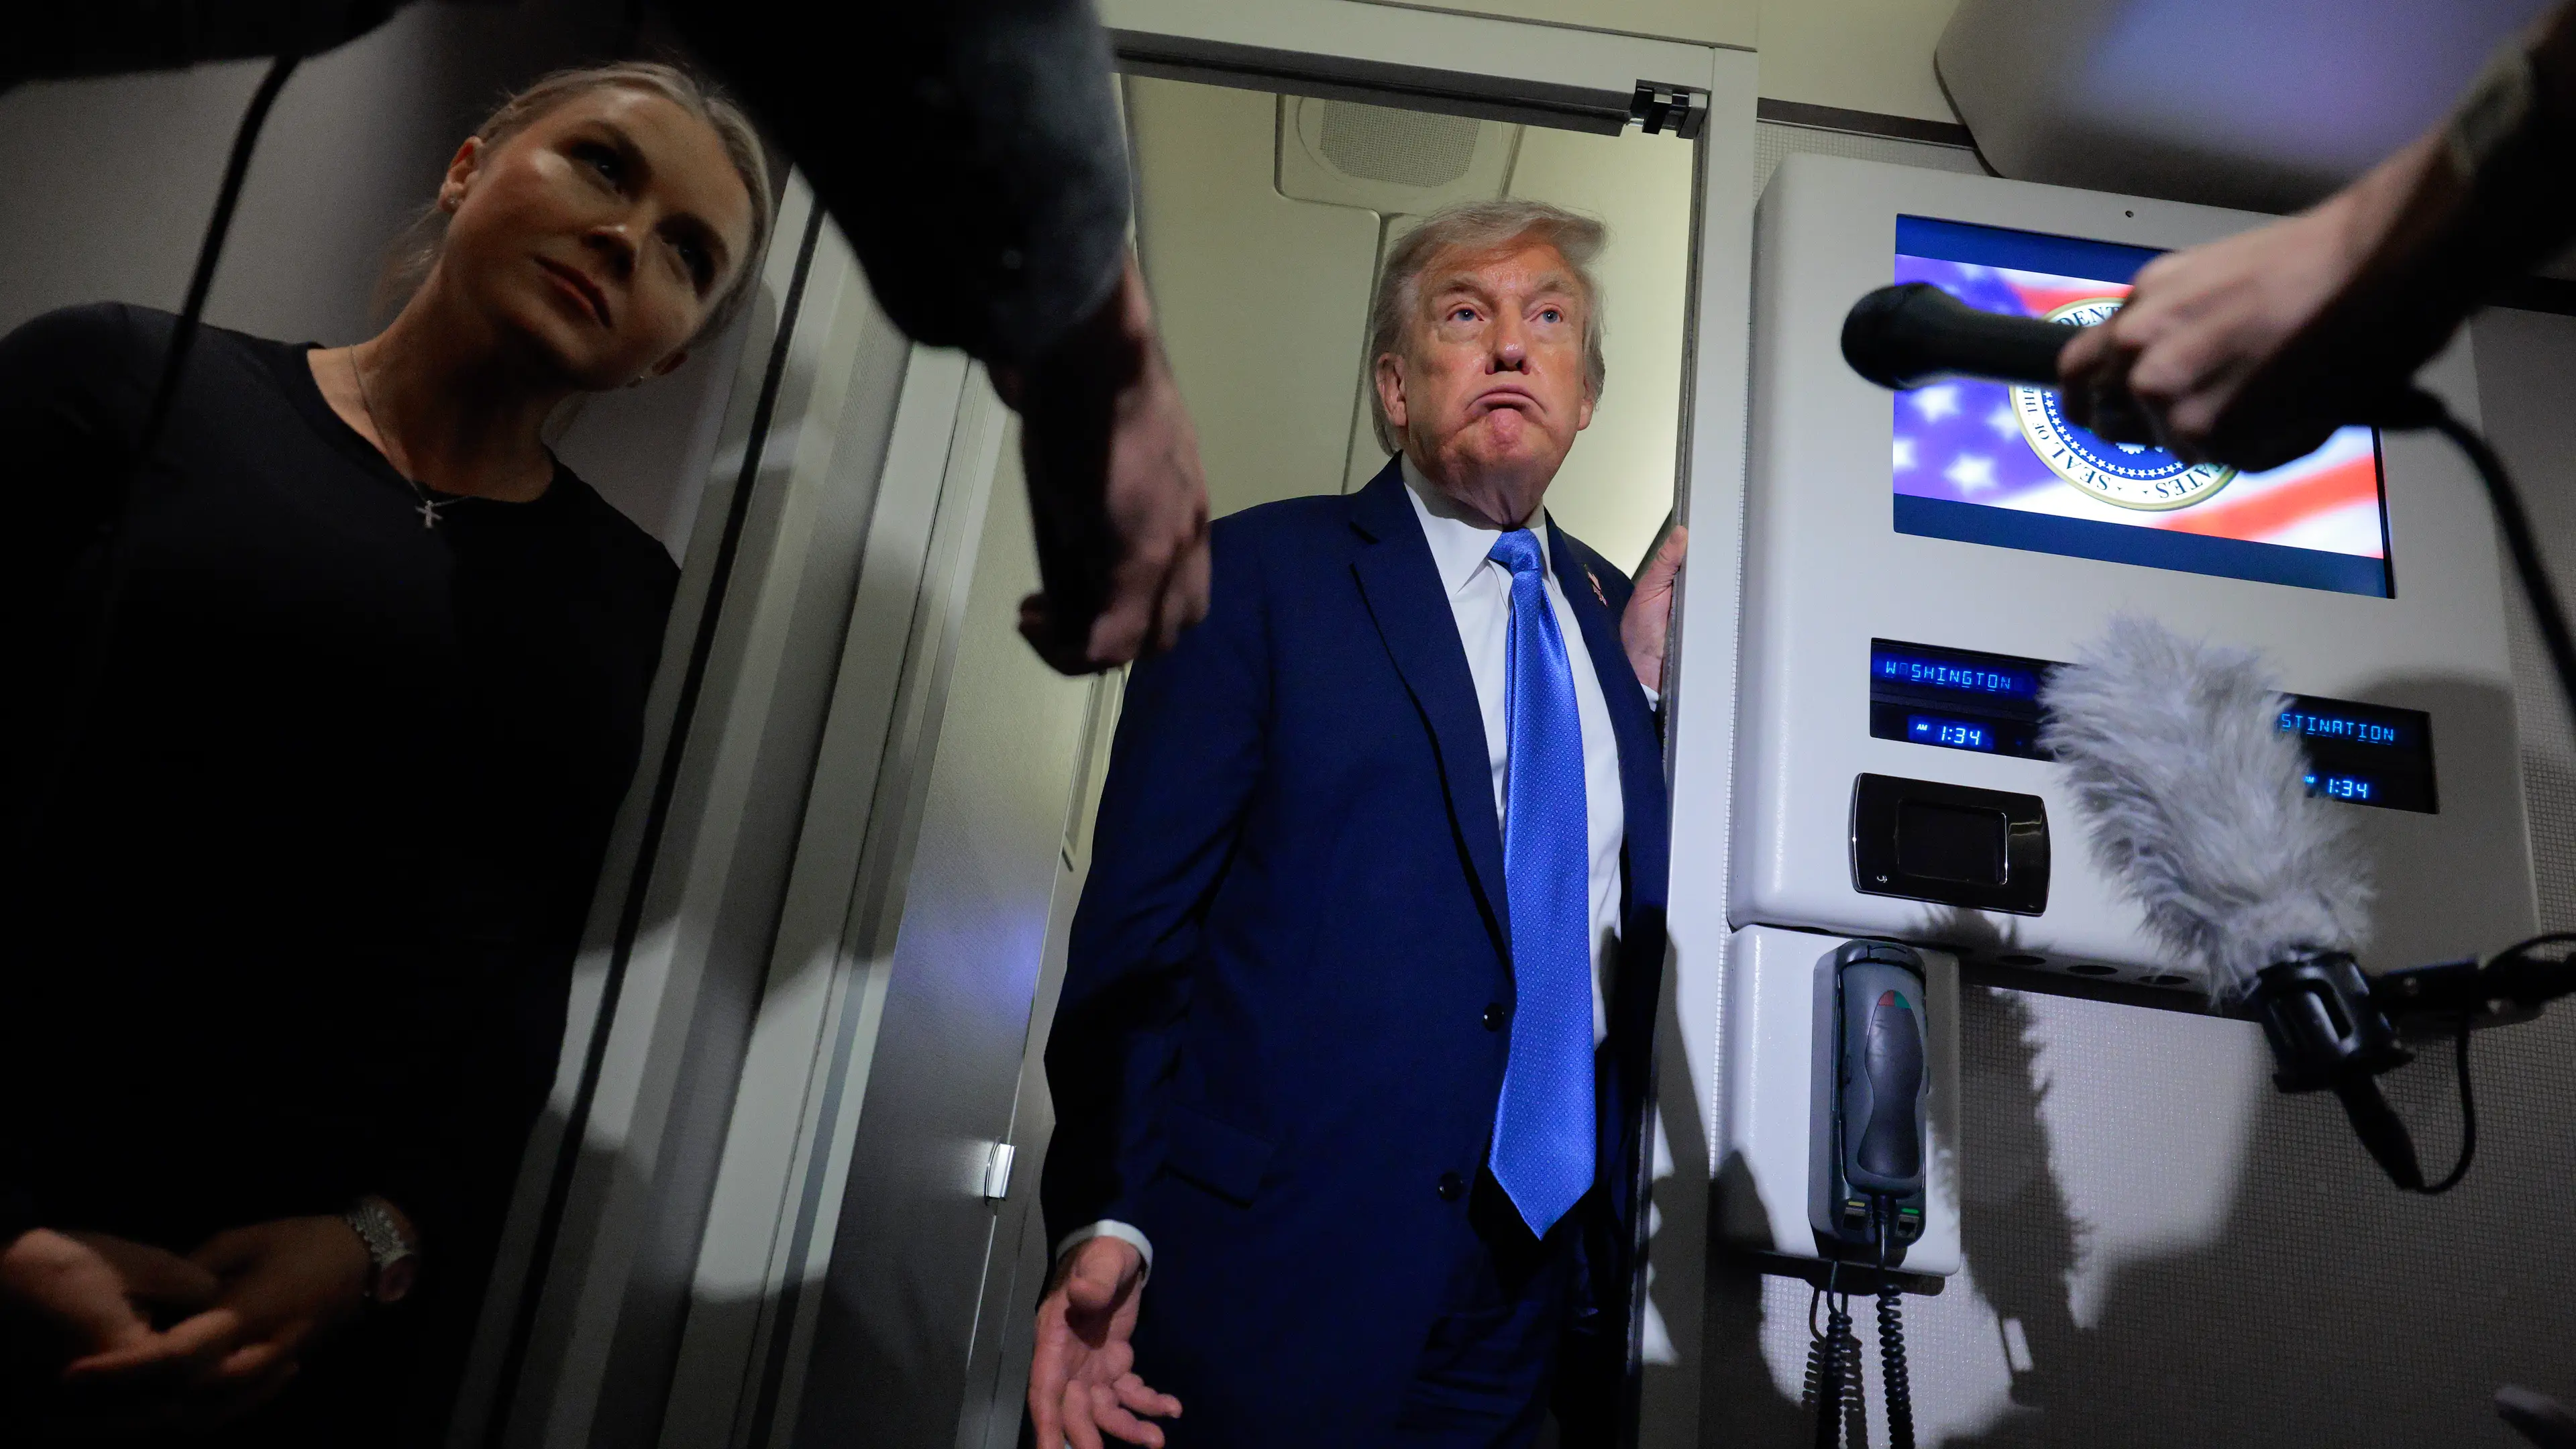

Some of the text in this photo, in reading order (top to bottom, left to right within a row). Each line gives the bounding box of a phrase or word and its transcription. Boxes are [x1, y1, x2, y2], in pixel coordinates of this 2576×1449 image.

[2033, 423, 2049, 440] OF
[2052, 442, 2110, 490] SEAL
[1886, 661, 2011, 690] WASHINGTON
[1941, 726, 1980, 745] 1:34
[2281, 714, 2394, 742] STINATION
[2328, 778, 2367, 798] 1:34
